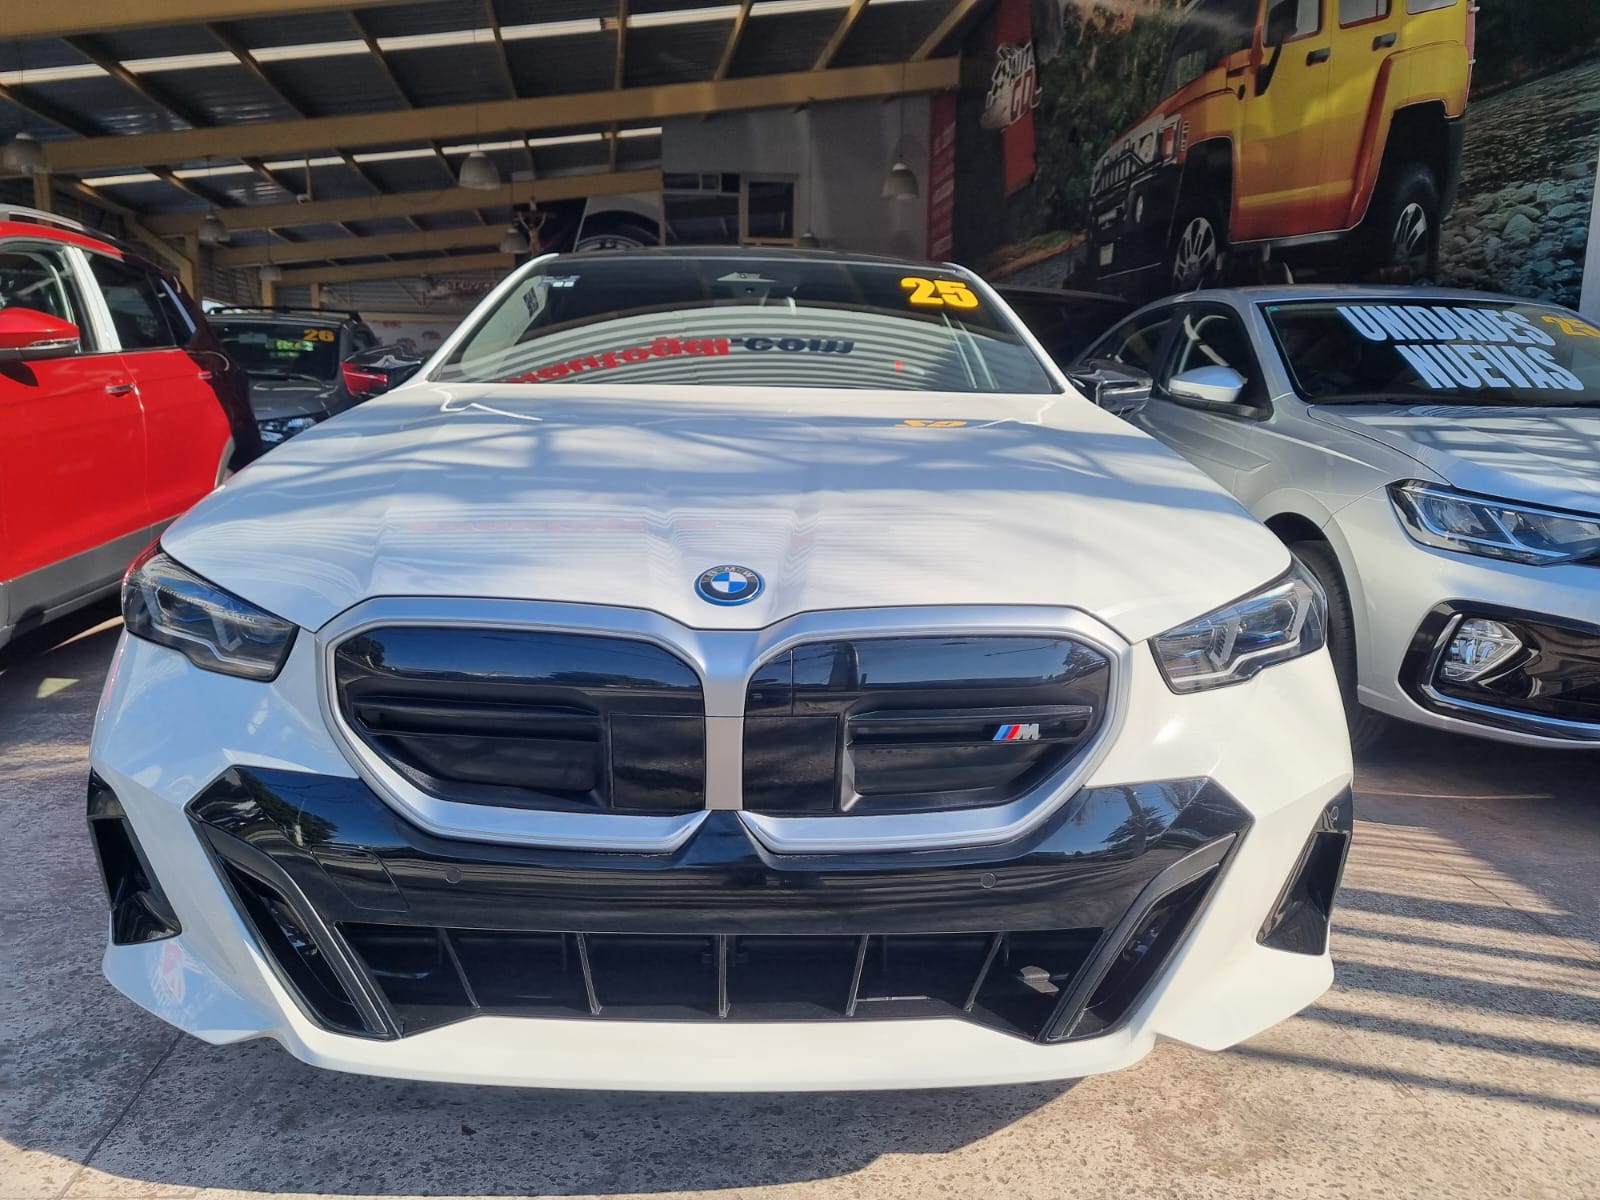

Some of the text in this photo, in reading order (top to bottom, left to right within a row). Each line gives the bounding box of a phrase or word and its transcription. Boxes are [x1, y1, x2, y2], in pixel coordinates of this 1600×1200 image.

[900, 276, 979, 308] 25
[303, 328, 335, 342] 26
[1336, 305, 1556, 346] UNIDADES
[1394, 344, 1585, 391] NUEVAS
